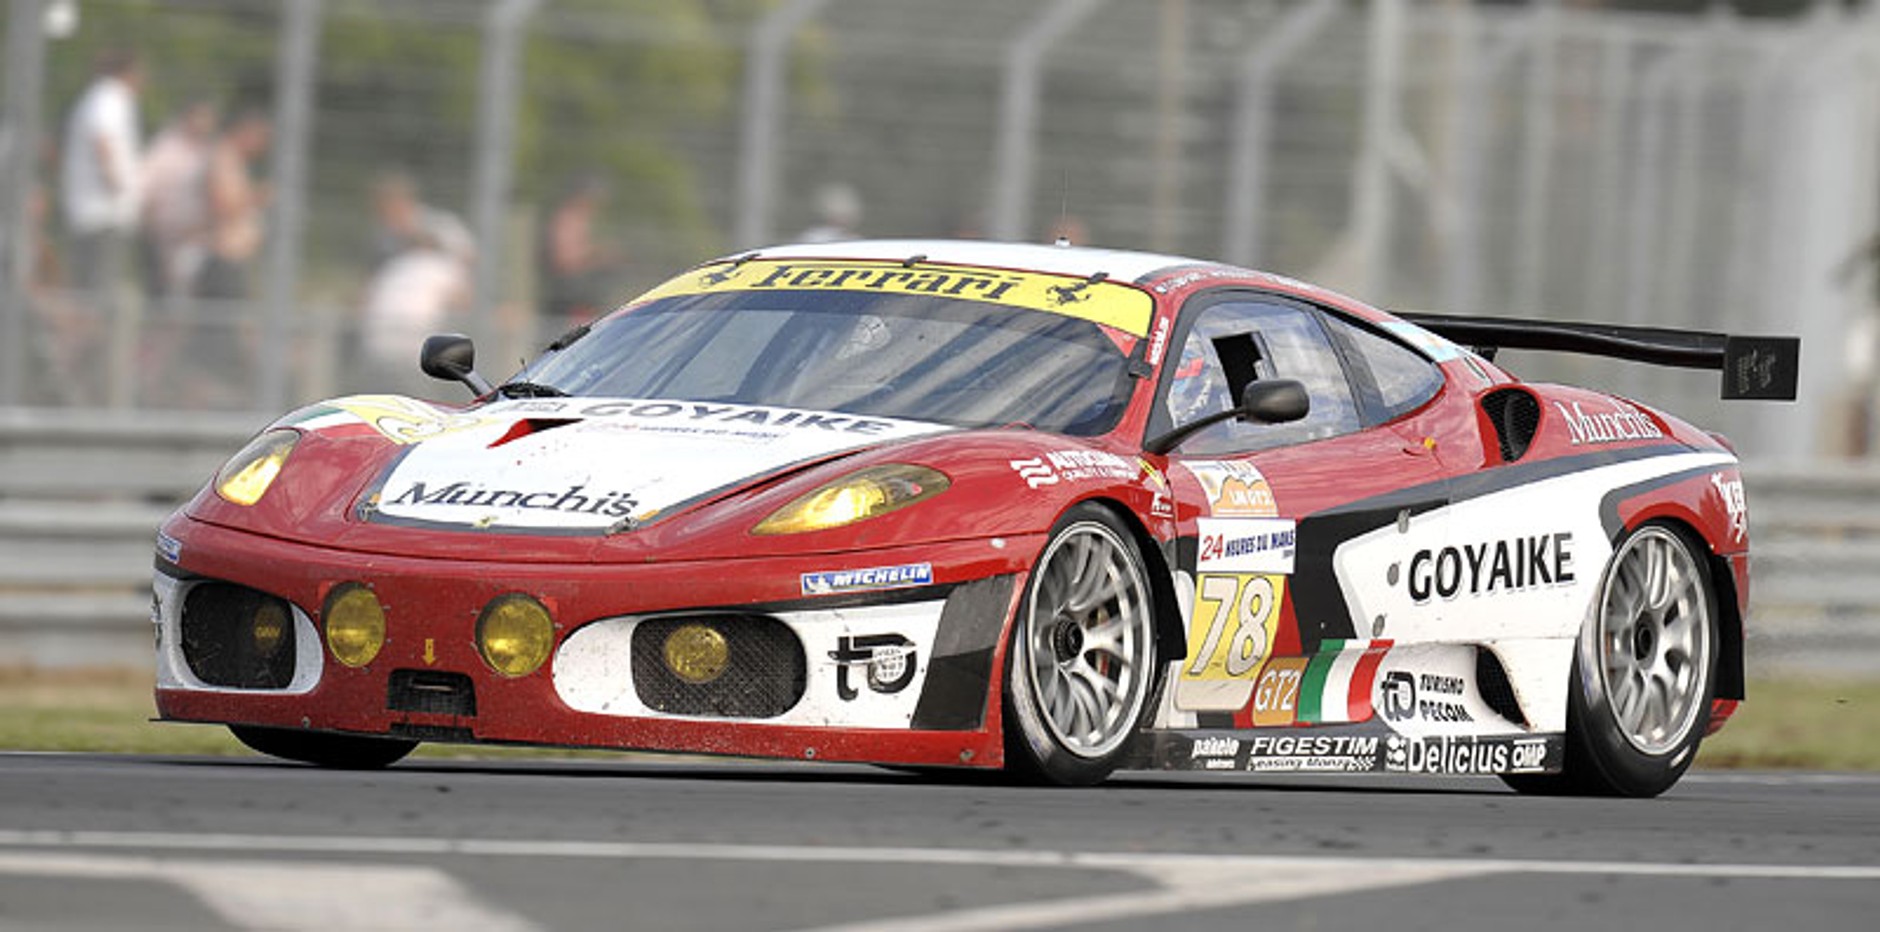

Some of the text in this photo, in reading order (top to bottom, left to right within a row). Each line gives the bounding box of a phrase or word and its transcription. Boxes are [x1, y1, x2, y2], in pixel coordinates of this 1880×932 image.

[751, 264, 1025, 300] Ferrari
[580, 402, 895, 435] GOYAIKE
[1200, 533, 1224, 561] 24
[1225, 535, 1256, 557] HEURES
[1257, 533, 1268, 552] DU
[831, 565, 929, 587] MICHELIN
[1408, 532, 1576, 603] GOYAIKE
[1187, 575, 1275, 676] 78
[1254, 669, 1300, 712] GT2
[1419, 674, 1465, 695] TURISMO
[1250, 736, 1379, 755] FIGESTIM
[1408, 734, 1508, 774] Delicius
[1511, 742, 1547, 770] OMP
